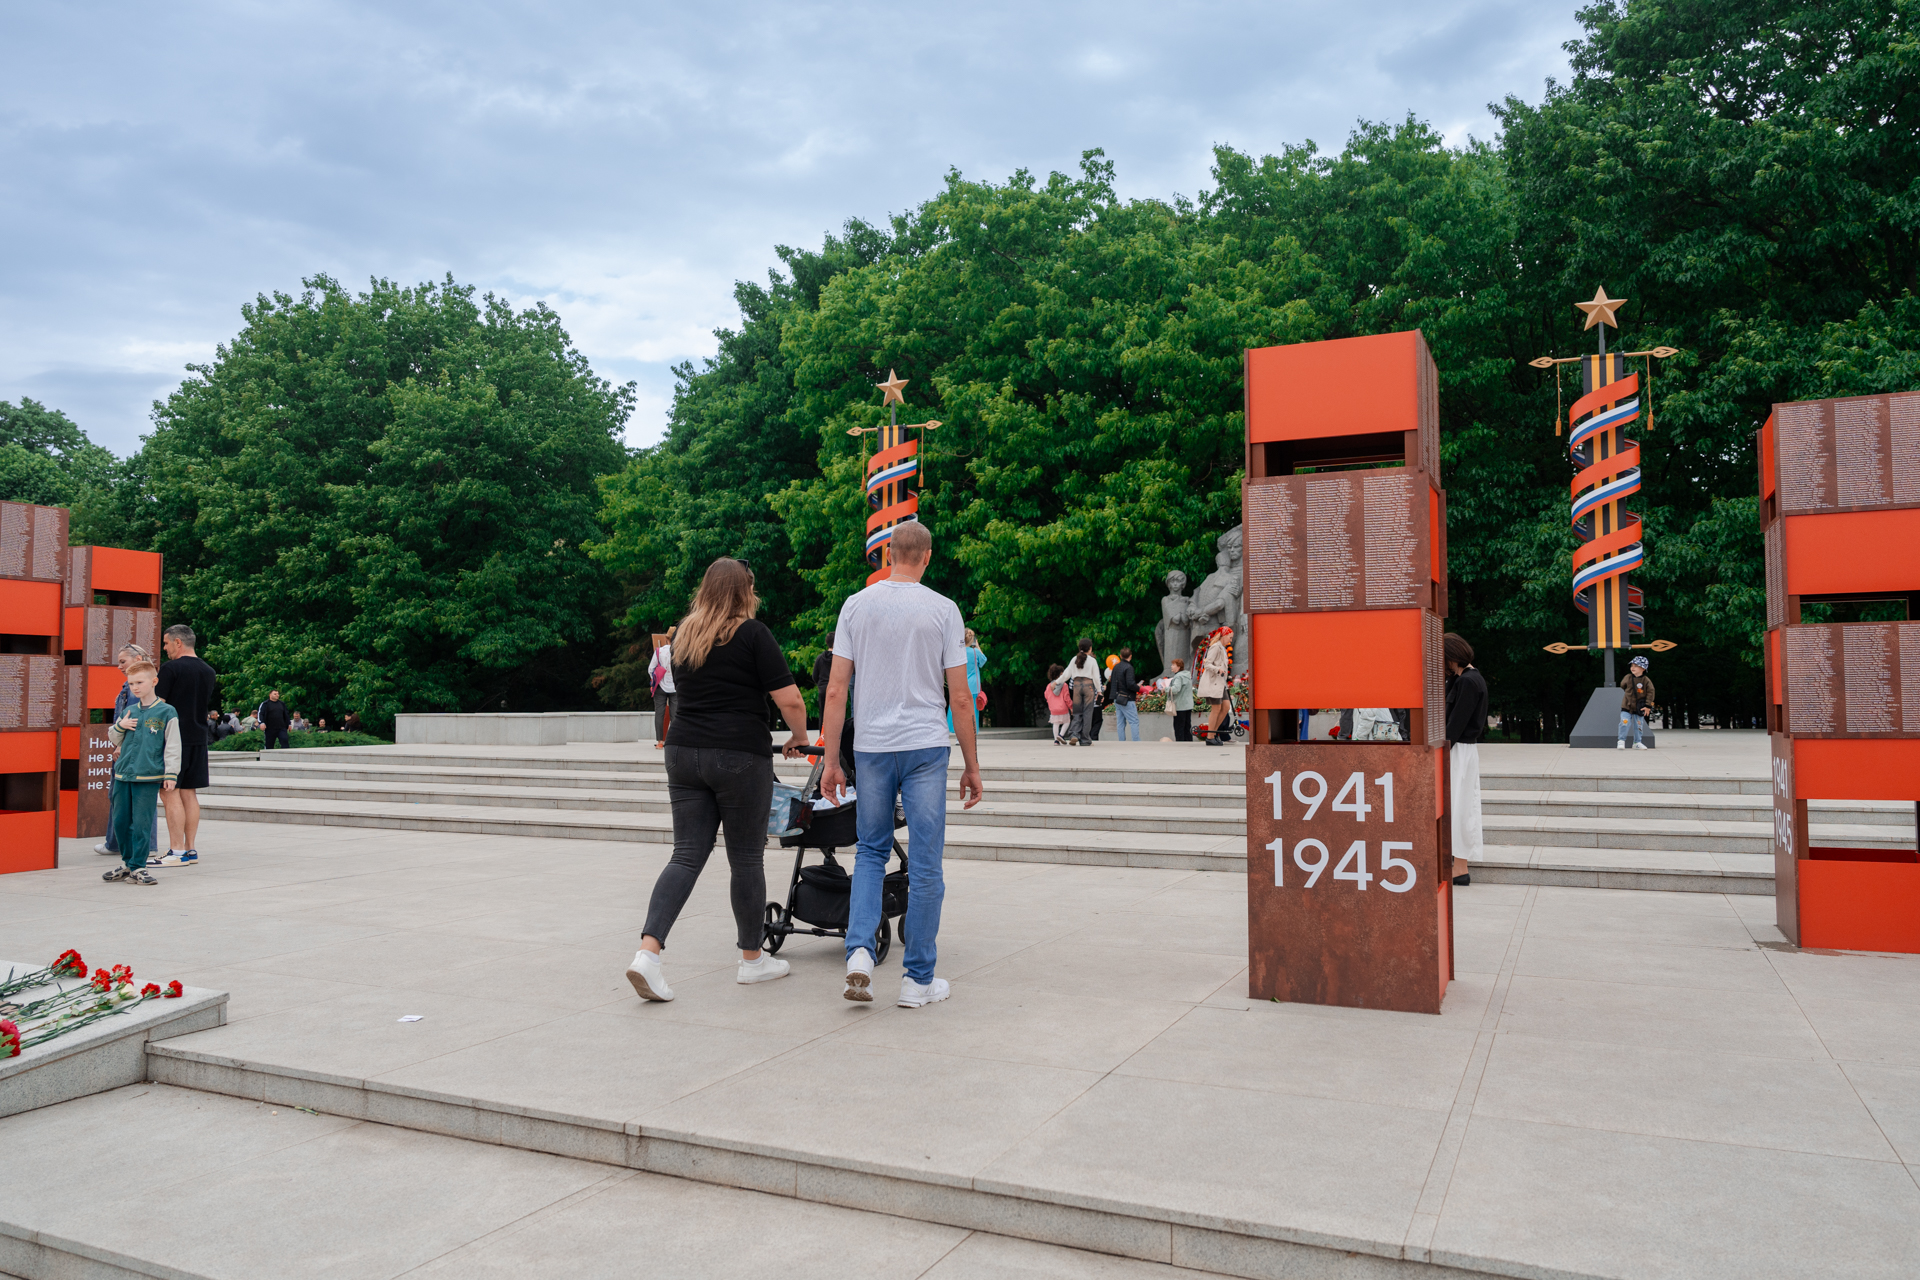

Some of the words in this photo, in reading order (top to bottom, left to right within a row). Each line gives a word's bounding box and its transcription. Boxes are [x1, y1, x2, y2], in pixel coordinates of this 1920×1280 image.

[89, 737, 115, 749] Ник
[88, 753, 104, 763] не
[88, 767, 112, 776] нич
[87, 781, 104, 790] не
[1773, 756, 1789, 800] 1941
[1264, 770, 1394, 823] 1941
[1774, 807, 1793, 855] 1945
[1265, 837, 1417, 893] 1945
